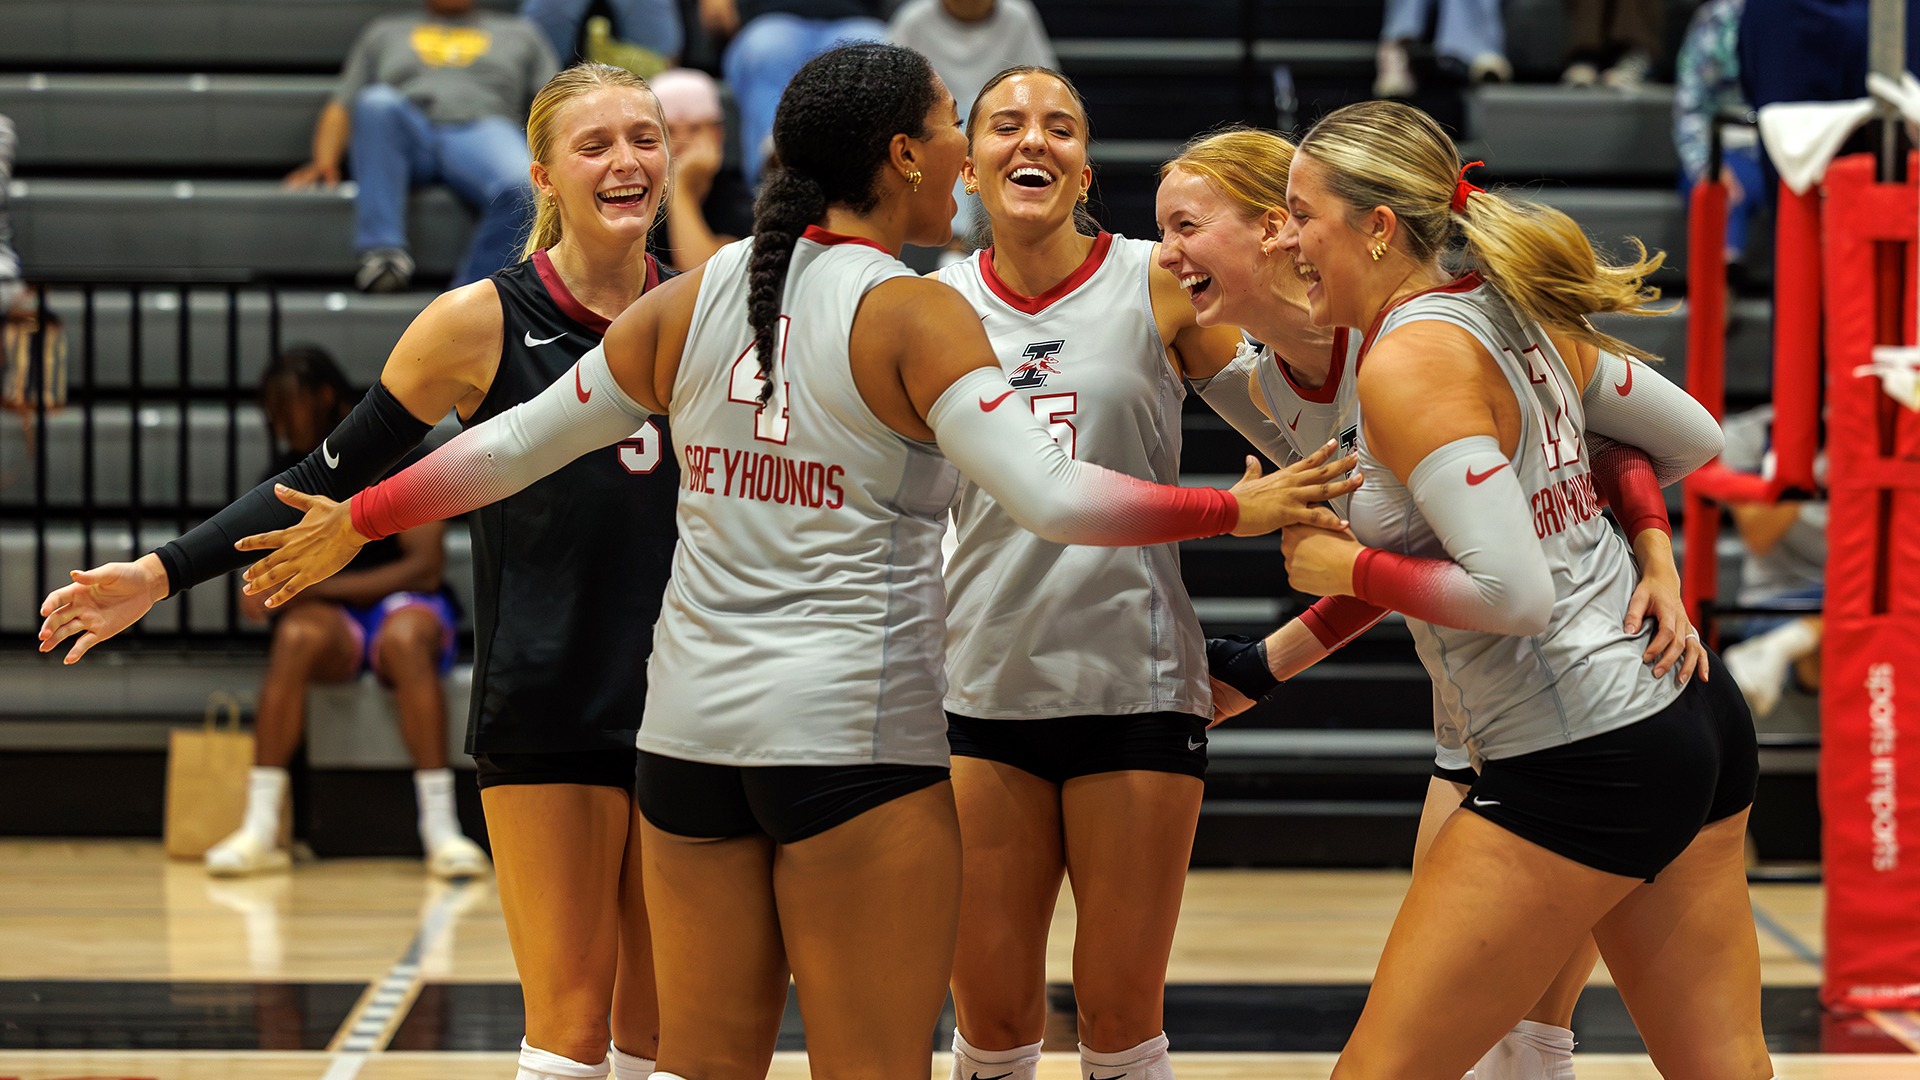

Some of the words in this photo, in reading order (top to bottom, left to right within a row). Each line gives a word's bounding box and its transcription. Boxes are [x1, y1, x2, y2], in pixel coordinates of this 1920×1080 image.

[728, 314, 791, 446] 4
[685, 445, 846, 510] GREYHOUNDS
[1864, 663, 1897, 756] sports
[1866, 757, 1900, 871] imports
